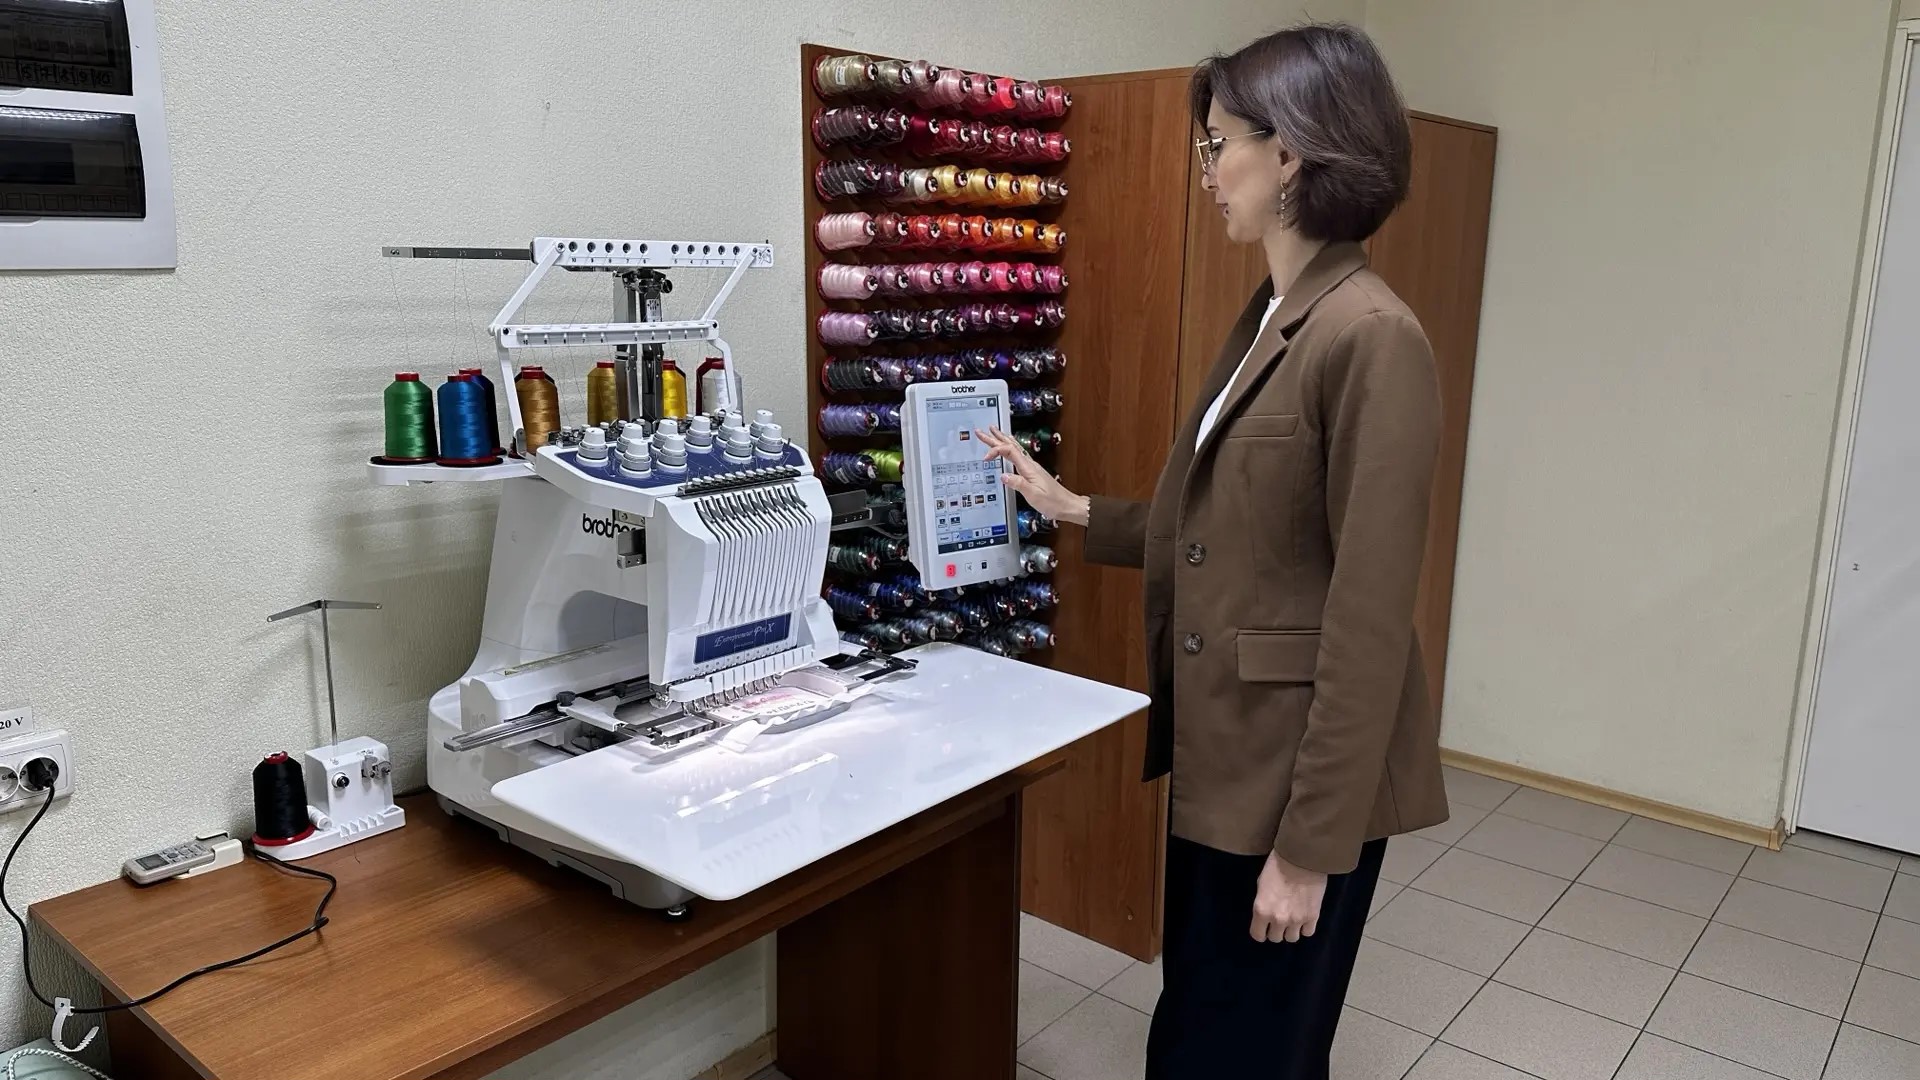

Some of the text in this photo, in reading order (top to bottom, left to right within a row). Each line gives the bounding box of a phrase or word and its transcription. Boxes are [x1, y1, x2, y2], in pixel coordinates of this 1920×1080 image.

[951, 385, 976, 394] brother
[583, 513, 637, 539] broth
[14, 716, 24, 726] V
